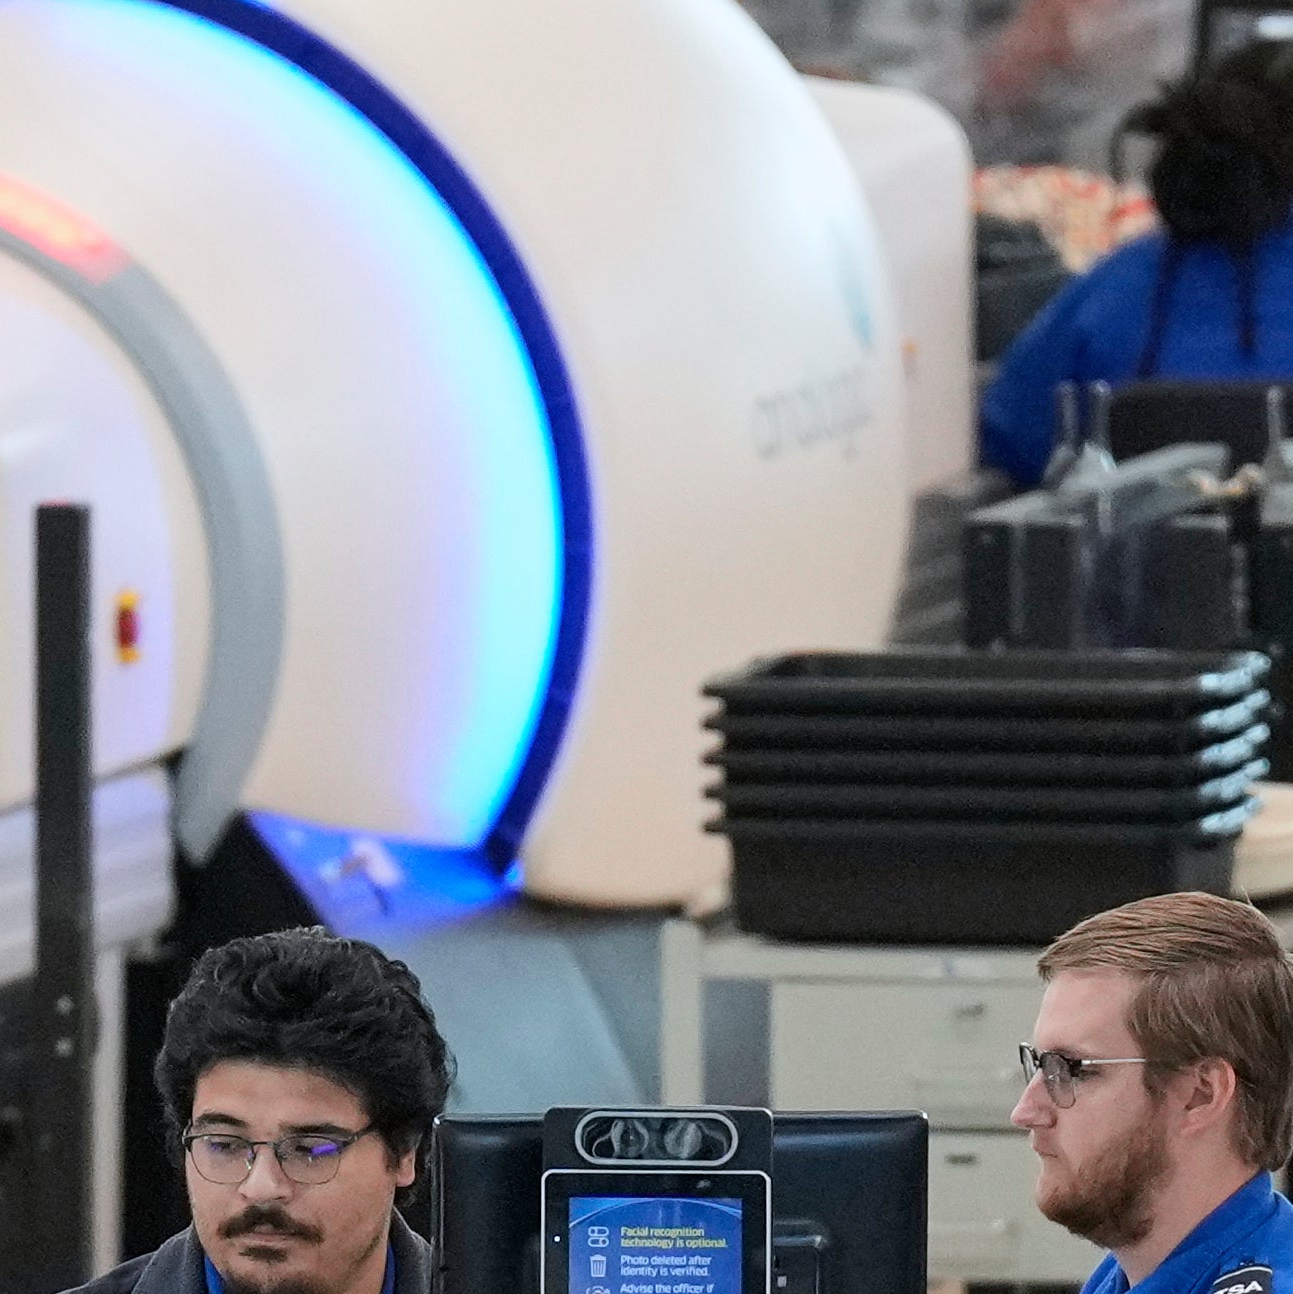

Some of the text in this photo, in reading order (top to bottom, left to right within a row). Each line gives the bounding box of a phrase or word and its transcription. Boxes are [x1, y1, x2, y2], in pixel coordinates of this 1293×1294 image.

[620, 1226, 705, 1239] Facial recognition
[620, 1237, 728, 1249] technology is optional.
[620, 1254, 712, 1265] Photo deleted after
[620, 1265, 710, 1277] identity is verified.
[620, 1283, 715, 1294] Advise the officer if
